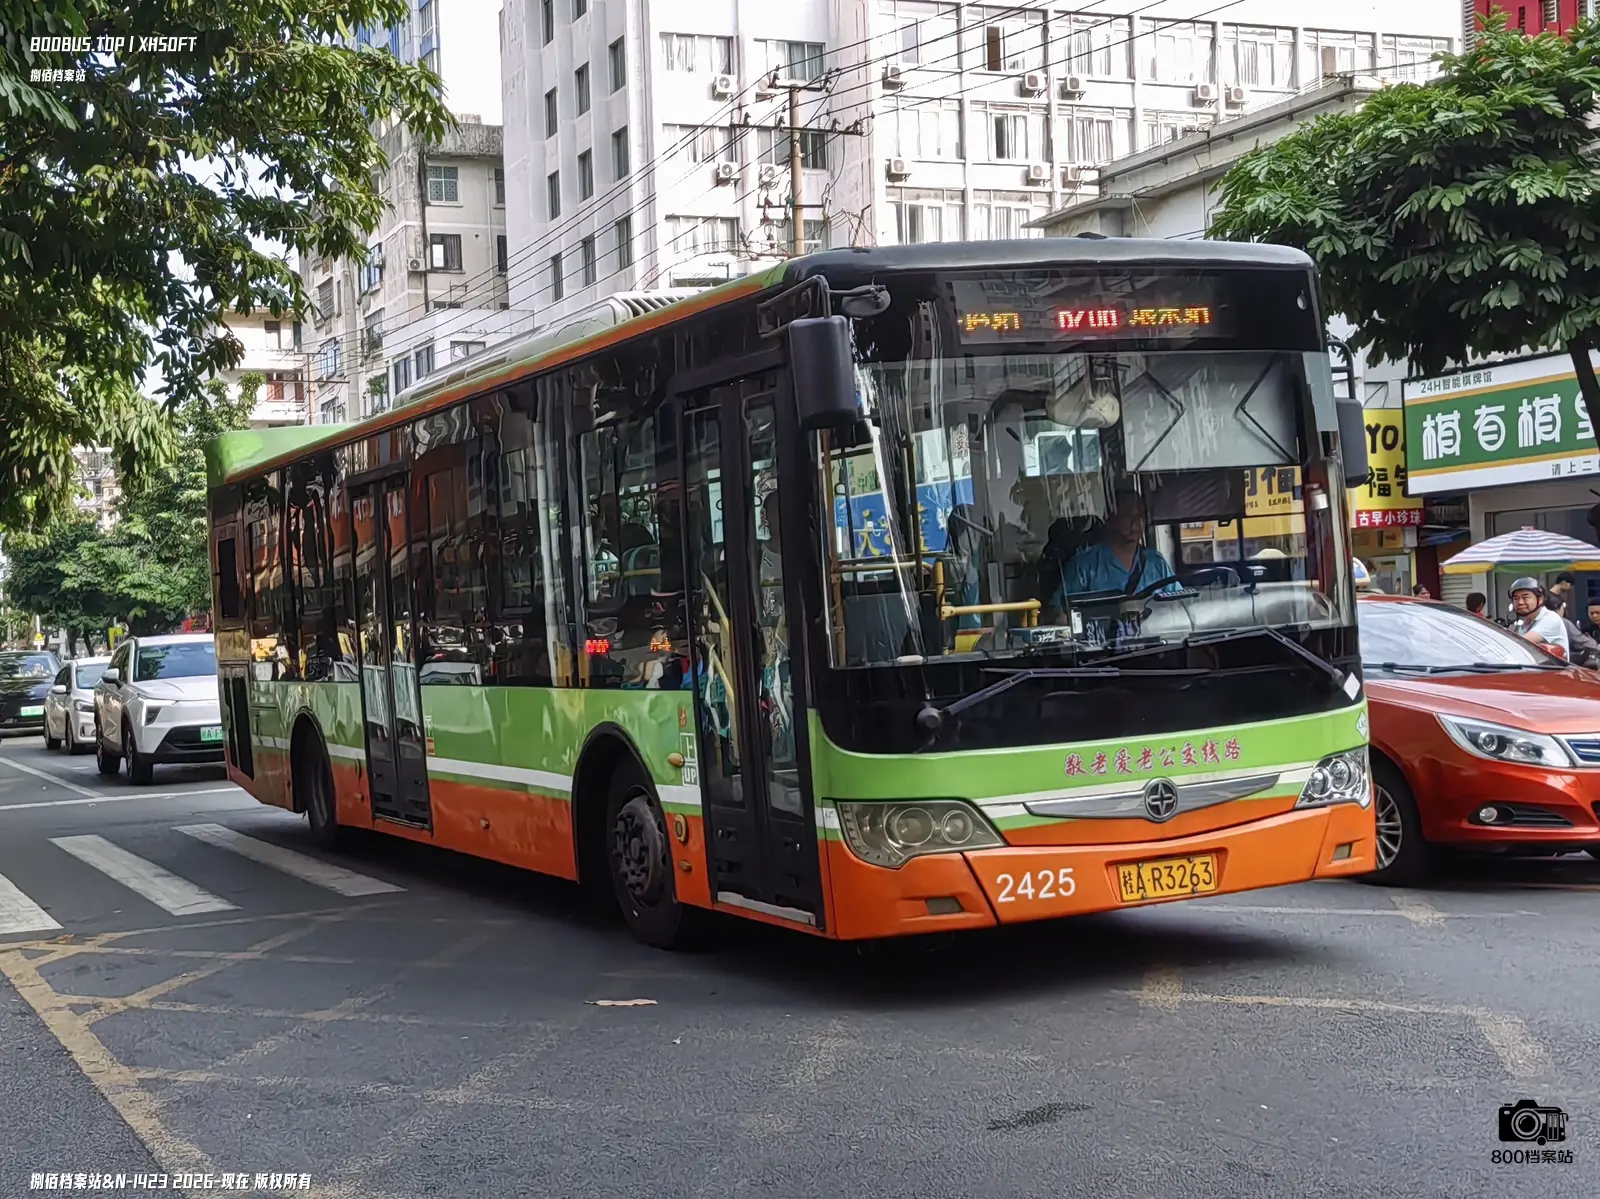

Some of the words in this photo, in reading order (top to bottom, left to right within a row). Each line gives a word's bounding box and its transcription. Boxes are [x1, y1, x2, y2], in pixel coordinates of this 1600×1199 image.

[1420, 371, 1492, 394] 24H智能棋牌馆
[1365, 422, 1406, 455] YO
[1551, 459, 1600, 476] 请上二
[1357, 509, 1421, 527] 古早小珍珠
[1064, 736, 1241, 777] 敬老爱老公交线路
[684, 766, 697, 784] UP
[996, 867, 1076, 903] 2425
